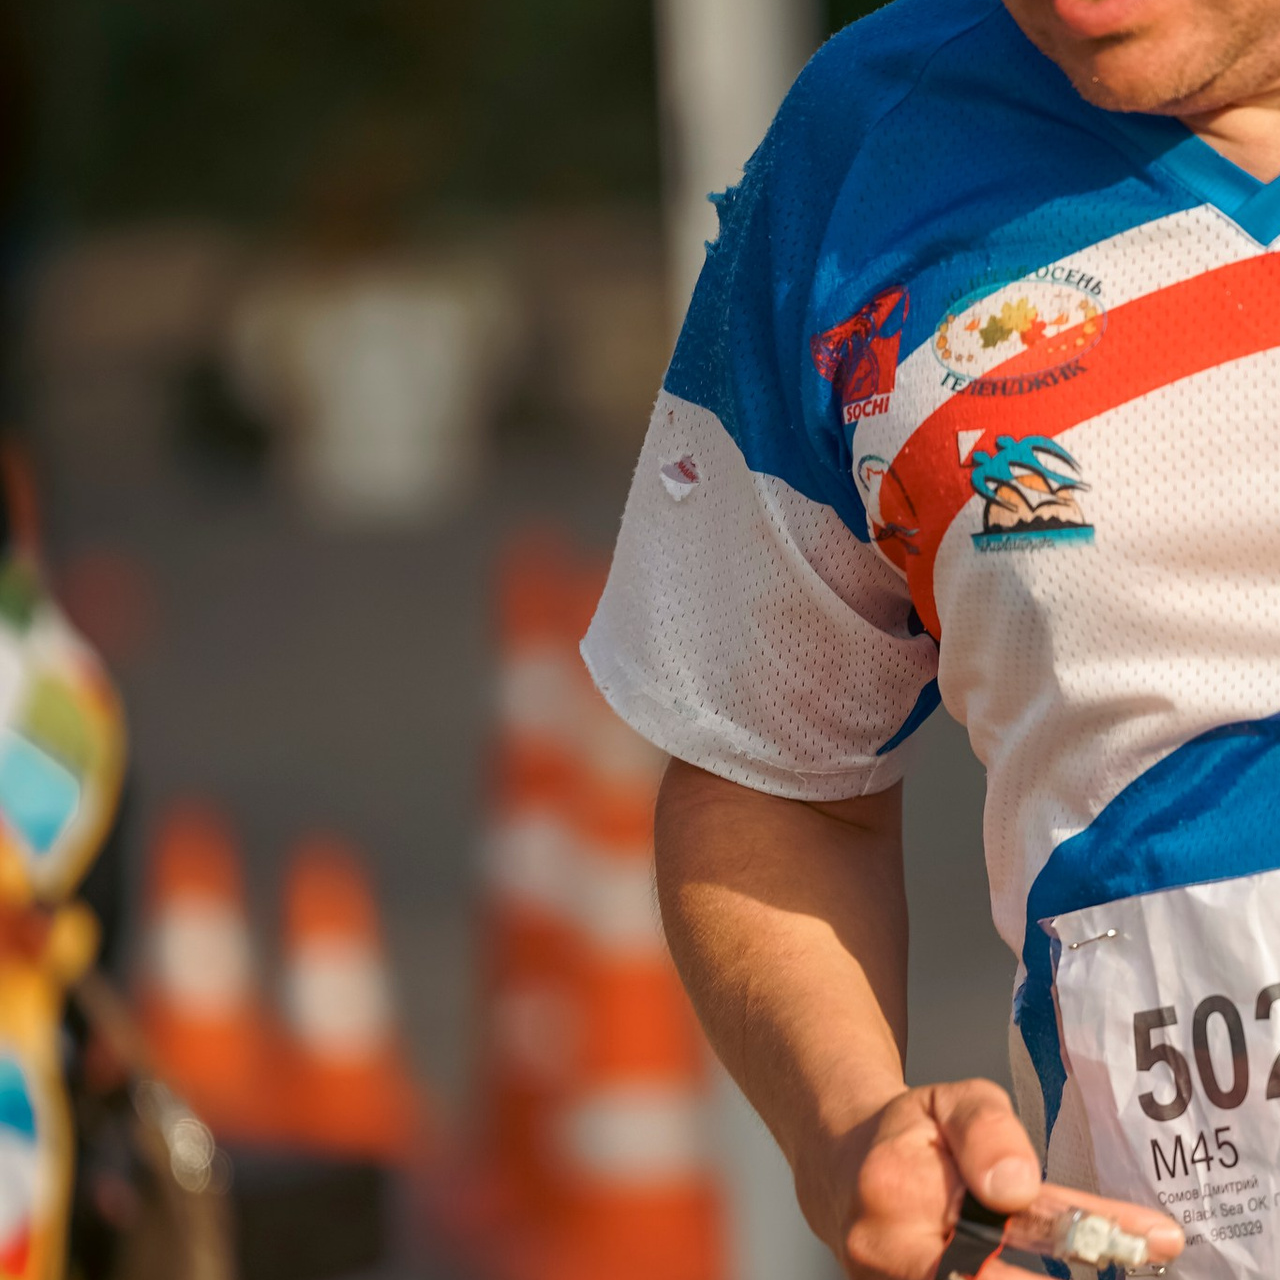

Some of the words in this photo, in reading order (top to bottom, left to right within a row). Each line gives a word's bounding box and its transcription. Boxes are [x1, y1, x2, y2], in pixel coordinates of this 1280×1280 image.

[846, 396, 890, 423] SOCHI
[1150, 1126, 1239, 1181] M45
[1157, 1188, 1199, 1206] Сомов
[1202, 1177, 1259, 1199] Дмитрий
[1183, 1207, 1218, 1224] Black
[1219, 1203, 1244, 1218] Sea
[1210, 1219, 1264, 1242] 9630329
